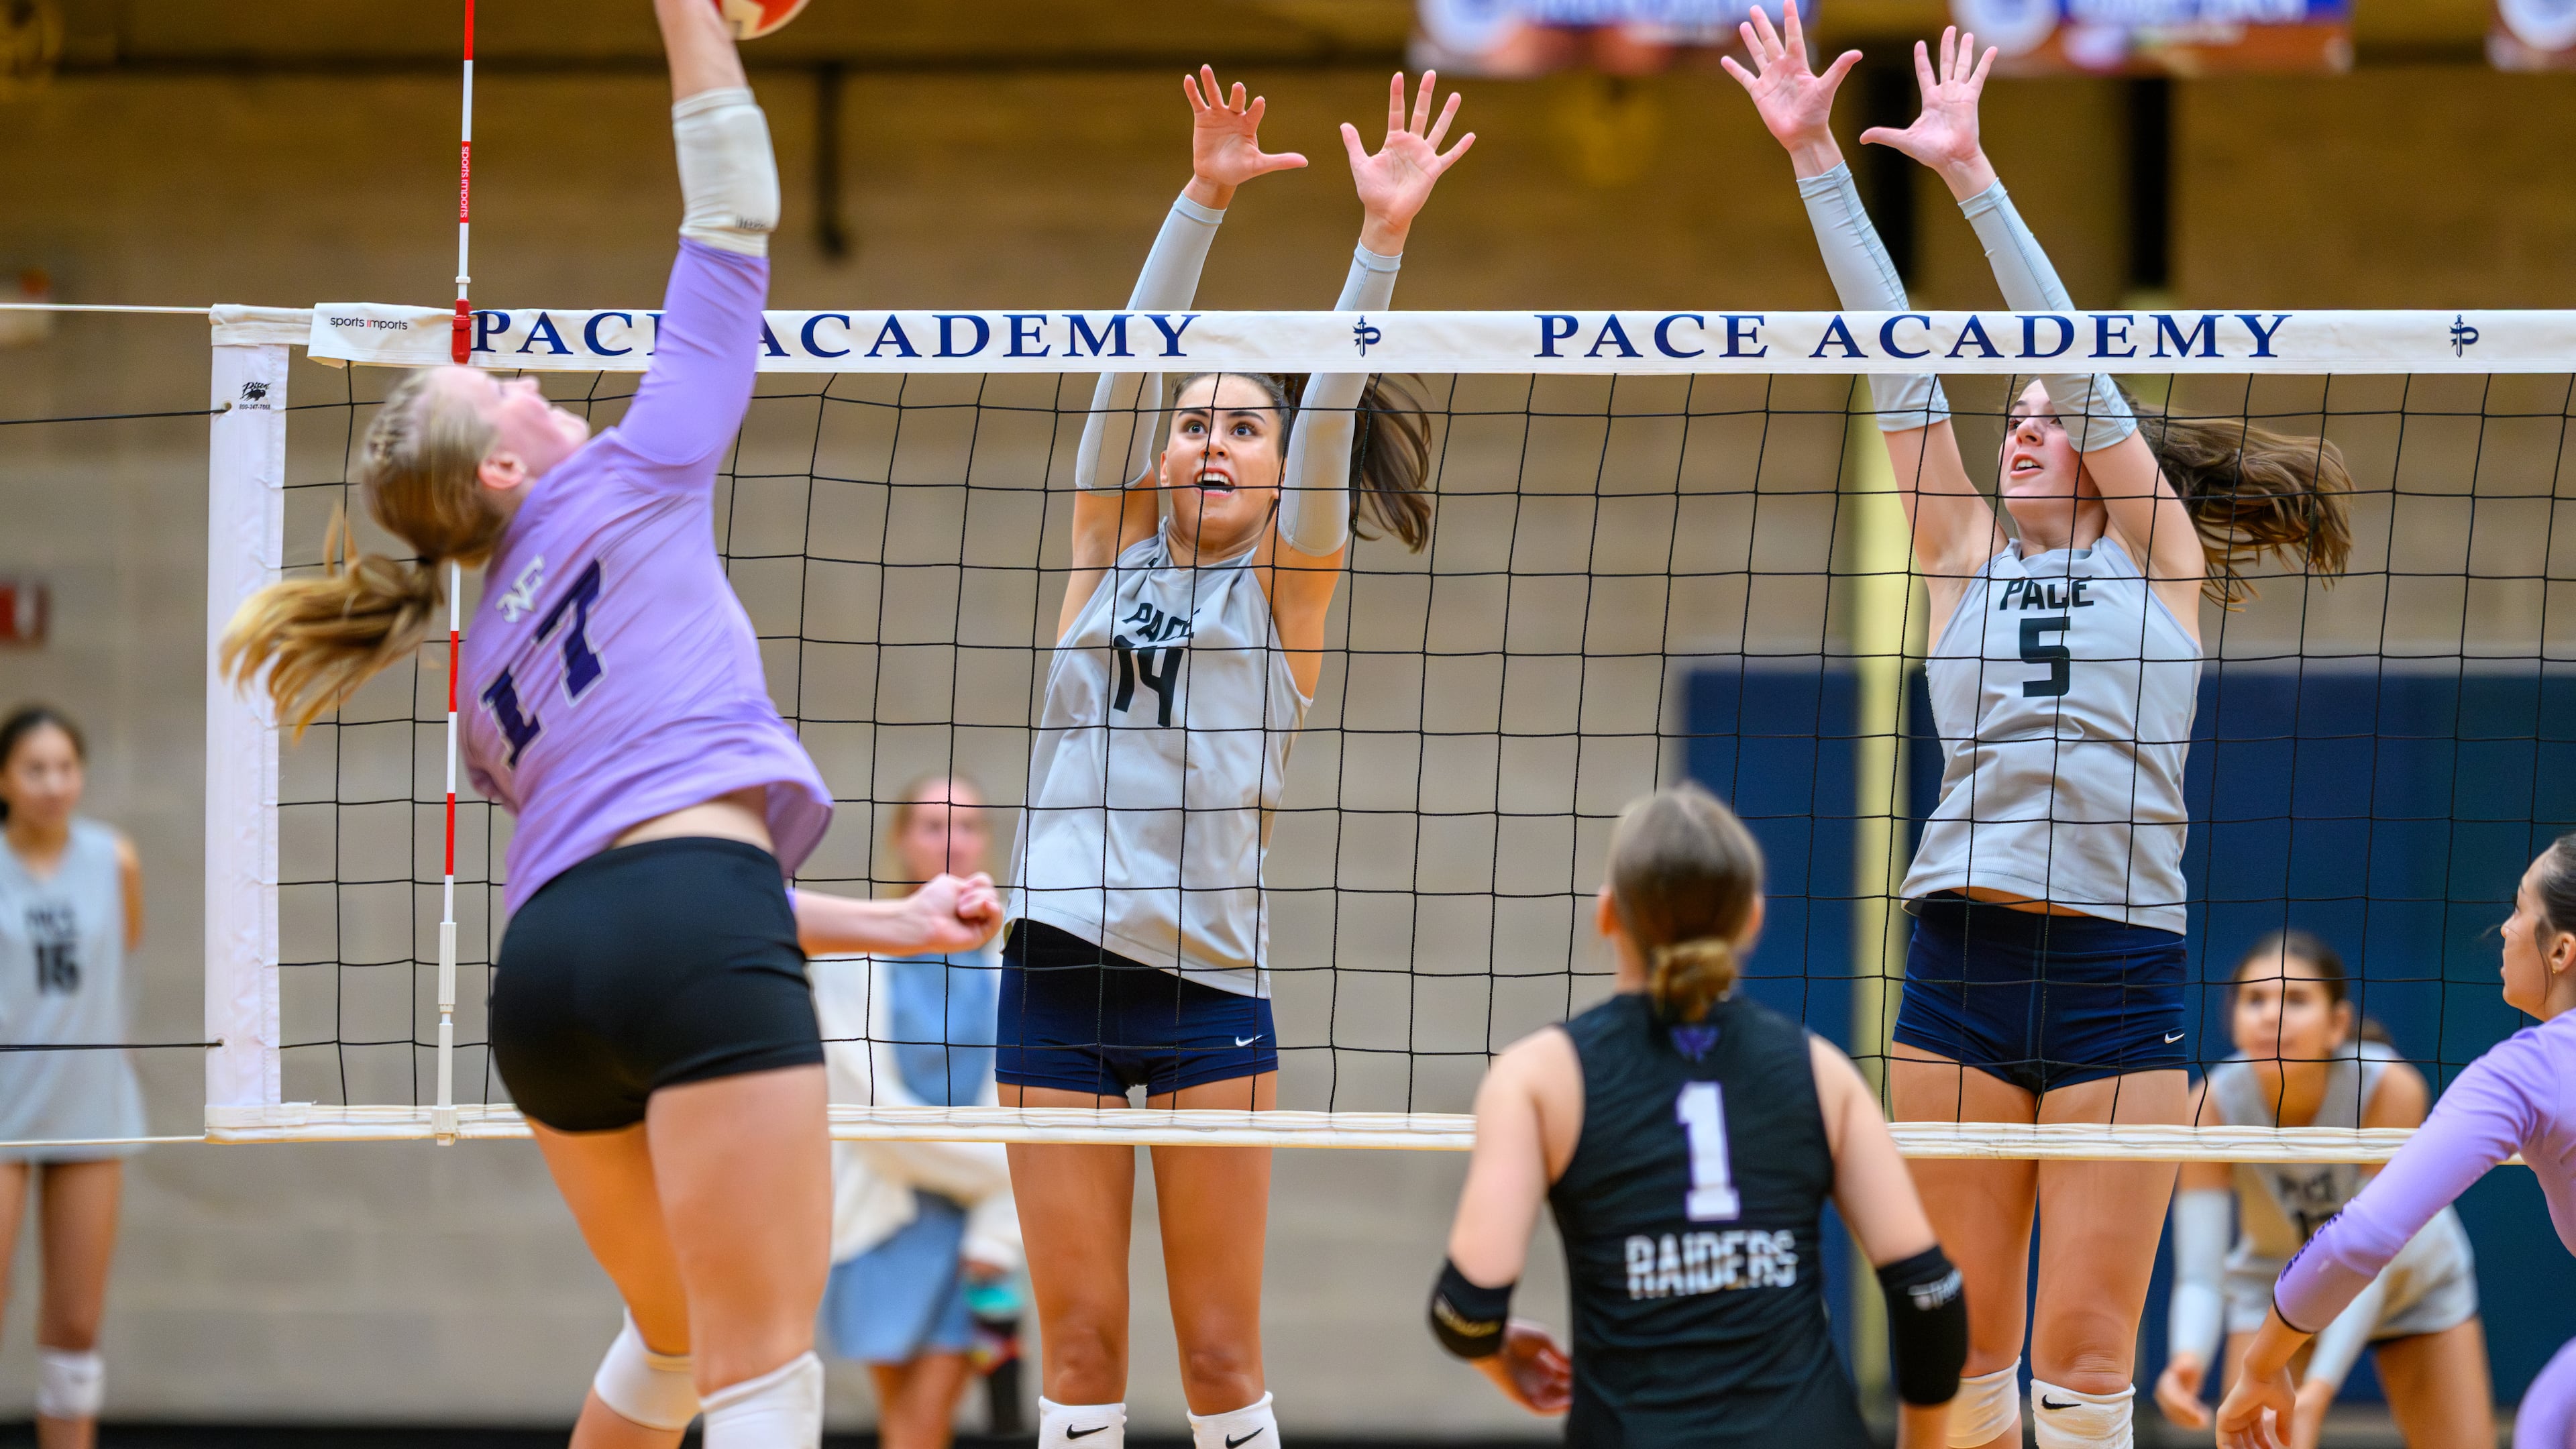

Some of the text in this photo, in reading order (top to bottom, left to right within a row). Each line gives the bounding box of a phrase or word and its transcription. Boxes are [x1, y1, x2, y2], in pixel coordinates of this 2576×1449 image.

[460, 146, 470, 218] sports imports
[330, 317, 409, 331] sports imports
[1534, 313, 2293, 359] PACE ACADEMY
[1999, 576, 2094, 610] PACE
[479, 558, 607, 773] 17
[1113, 635, 1184, 727] 14
[2019, 616, 2071, 698] 5
[1676, 1081, 1741, 1222] 1
[1625, 1229, 1799, 1300] RAIDERS
